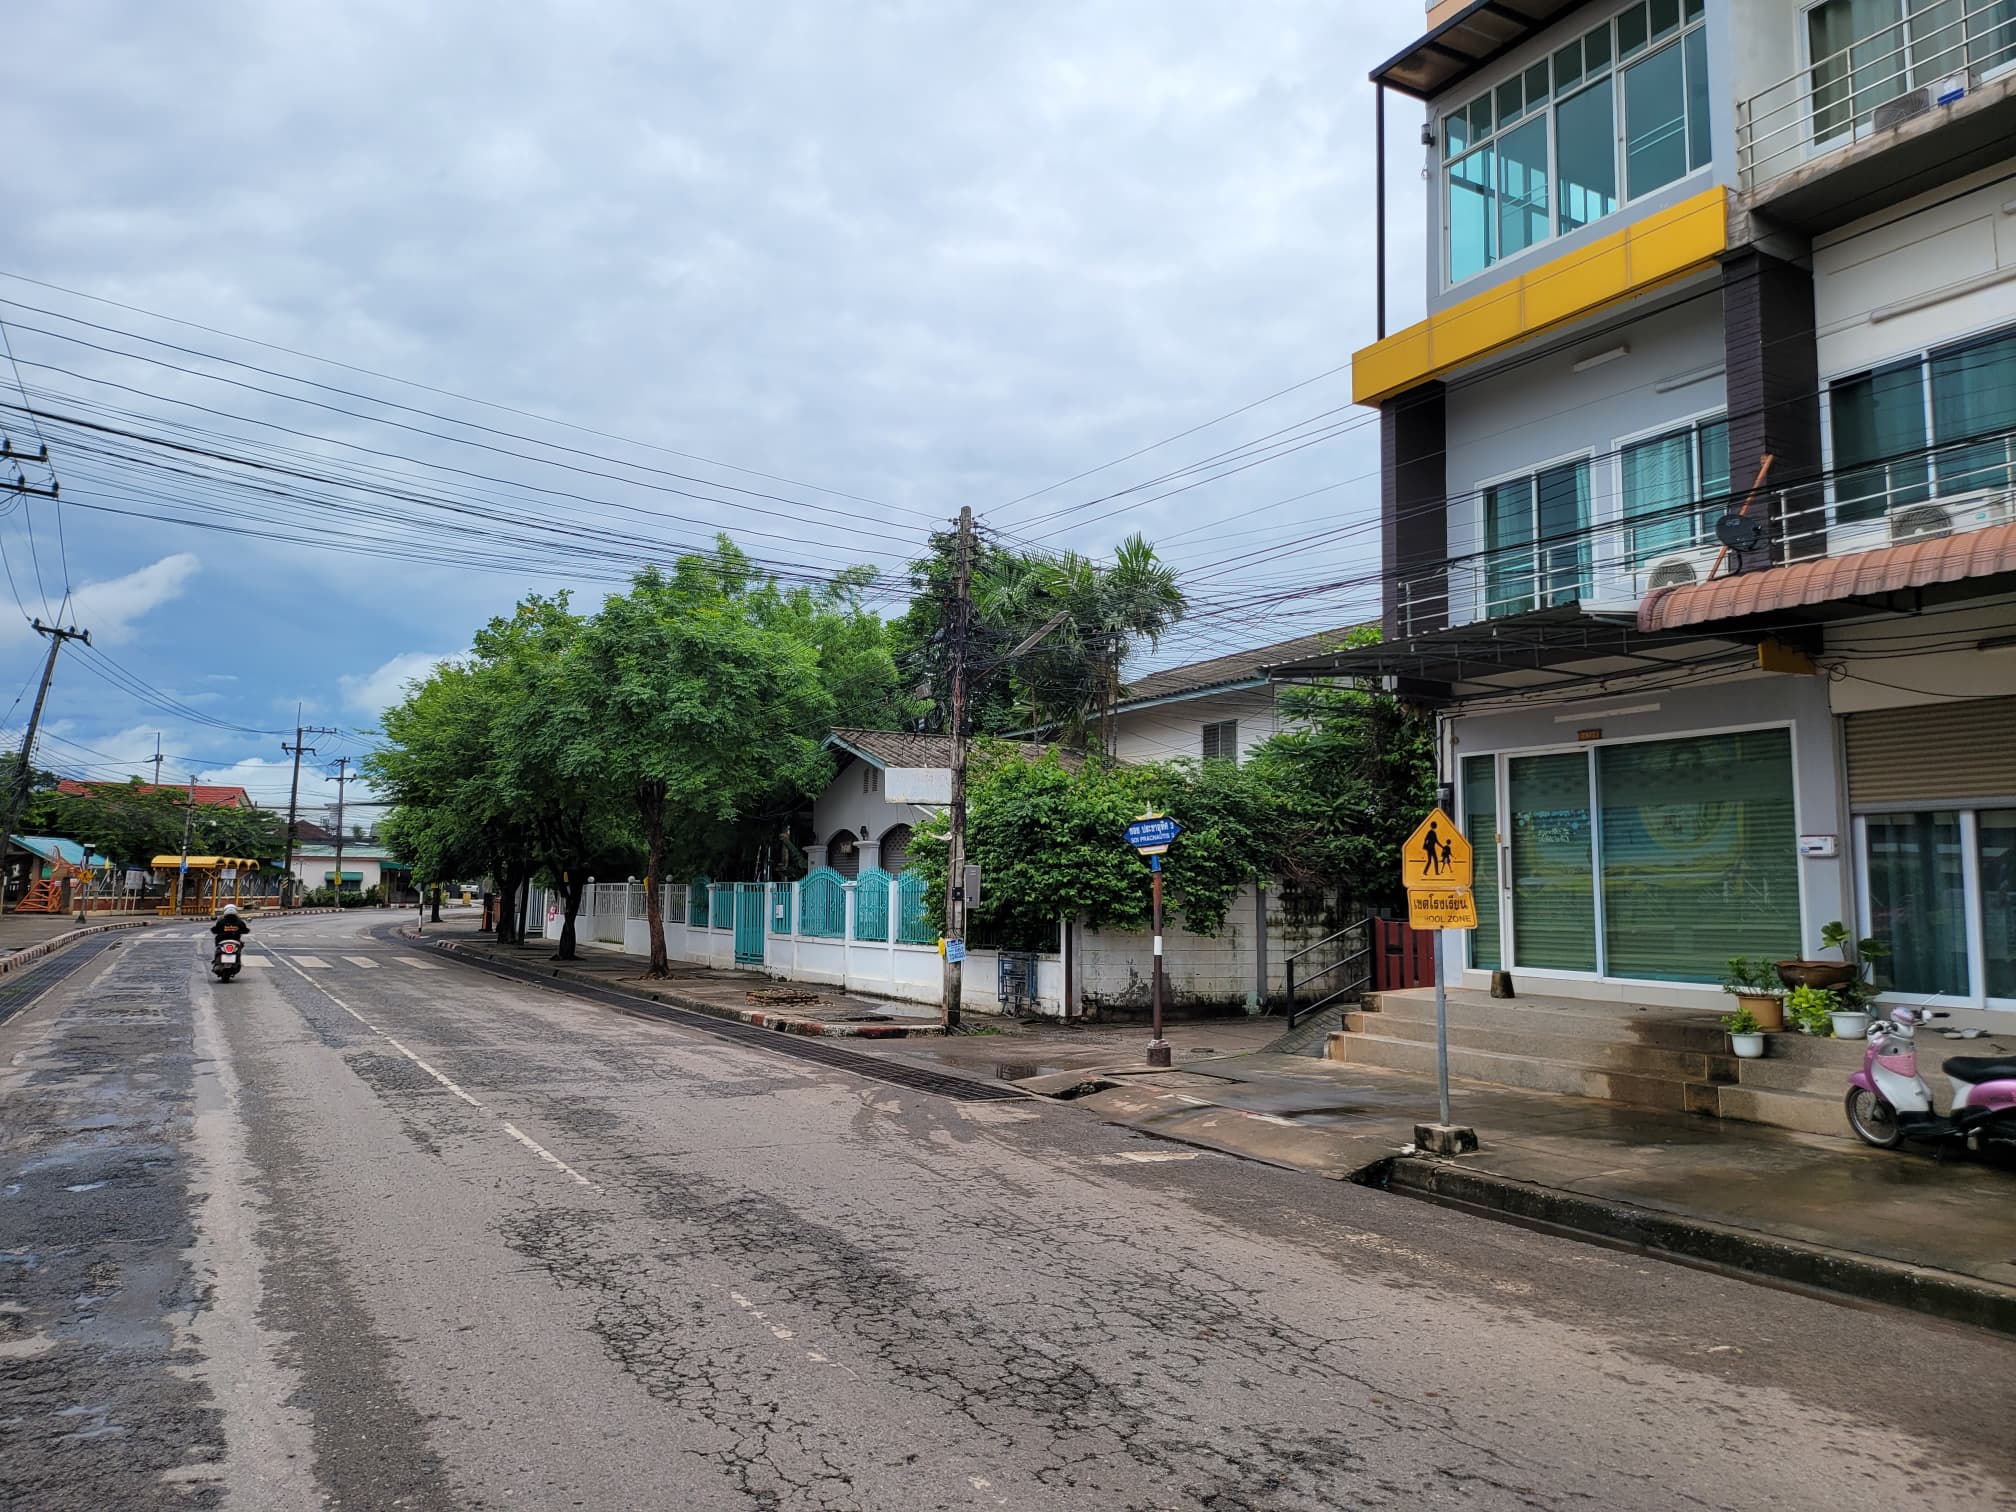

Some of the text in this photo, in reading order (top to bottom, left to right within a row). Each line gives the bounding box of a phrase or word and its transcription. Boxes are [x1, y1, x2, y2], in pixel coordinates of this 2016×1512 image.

[1413, 894, 1468, 911] เขตโรงเรียน
[1447, 914, 1472, 923] ZONE
